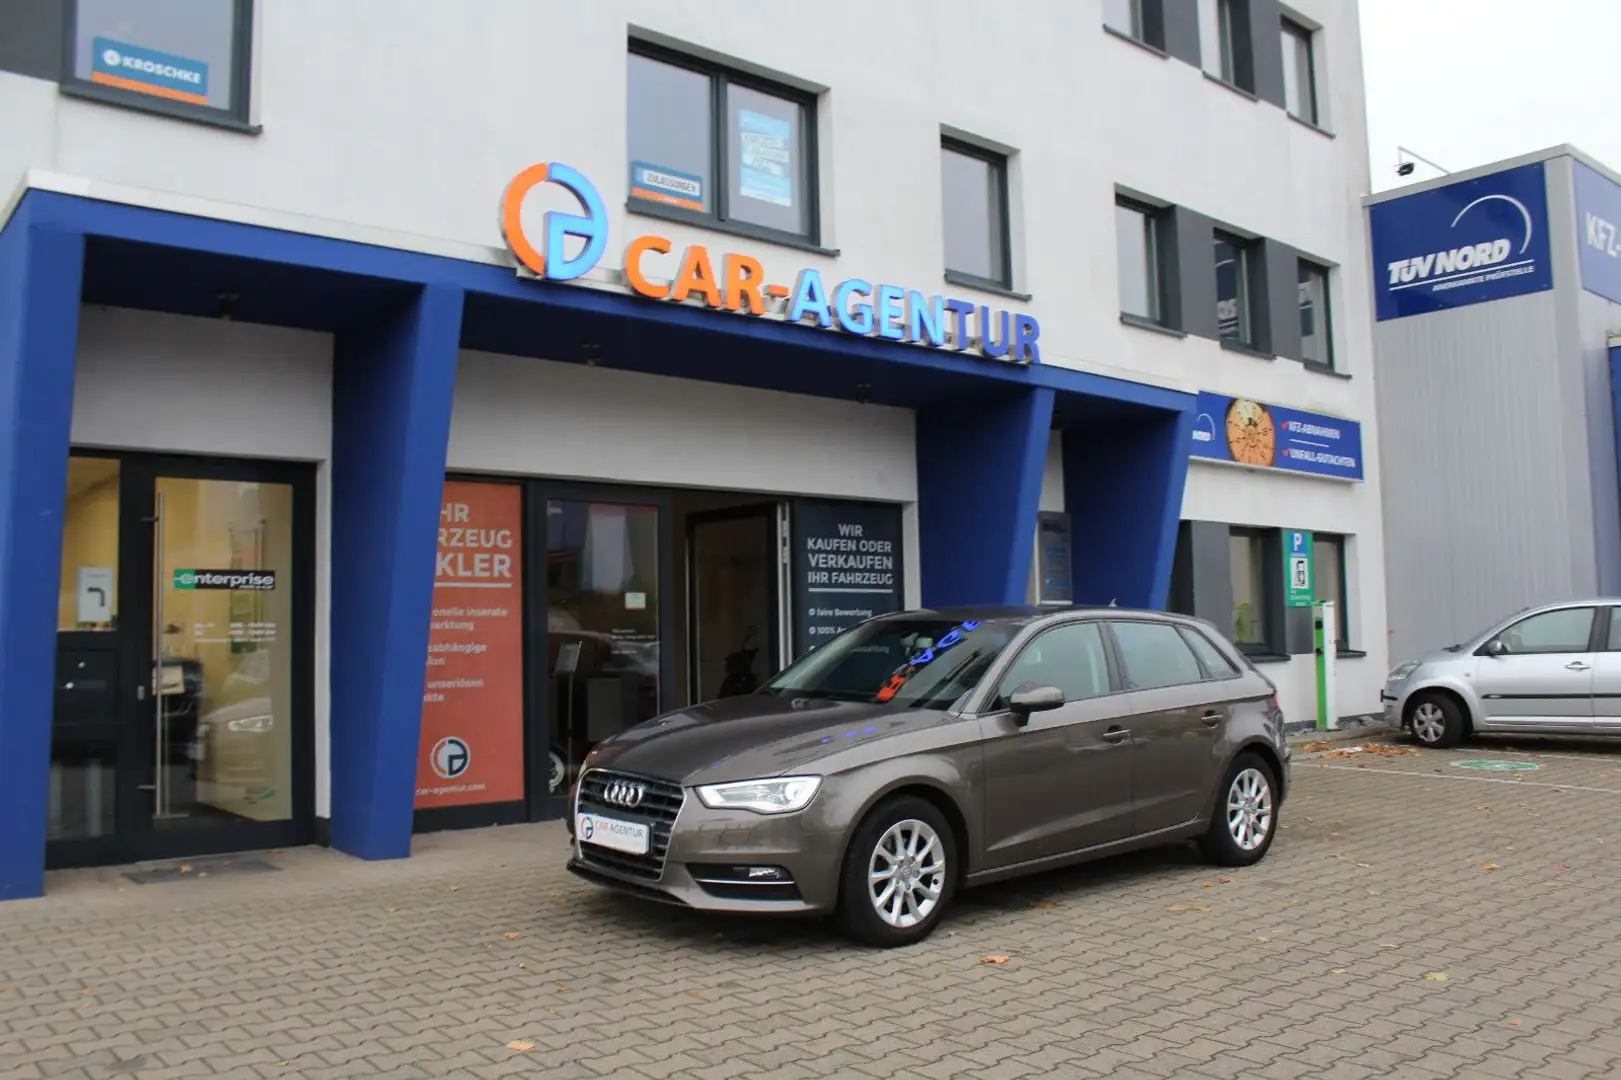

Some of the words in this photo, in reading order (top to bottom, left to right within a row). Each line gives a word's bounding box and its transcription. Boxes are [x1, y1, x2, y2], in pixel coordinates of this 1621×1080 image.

[123, 56, 201, 84] KROSCHKE
[1434, 238, 1512, 276] NORD
[623, 234, 1042, 366] CAR-AGENTUR
[838, 524, 864, 537] WIR
[807, 537, 857, 552] KAUFEN
[859, 540, 892, 553] ODER
[1293, 532, 1302, 551] P
[435, 551, 512, 578] KLER
[807, 553, 893, 570] VERKAUFEN
[179, 573, 275, 587] enterprise
[807, 571, 829, 584] IHR
[831, 572, 893, 585] FAHRZEUG
[817, 607, 834, 616] faire
[834, 608, 873, 619] Bewertung
[610, 823, 644, 839] AGENTUR
